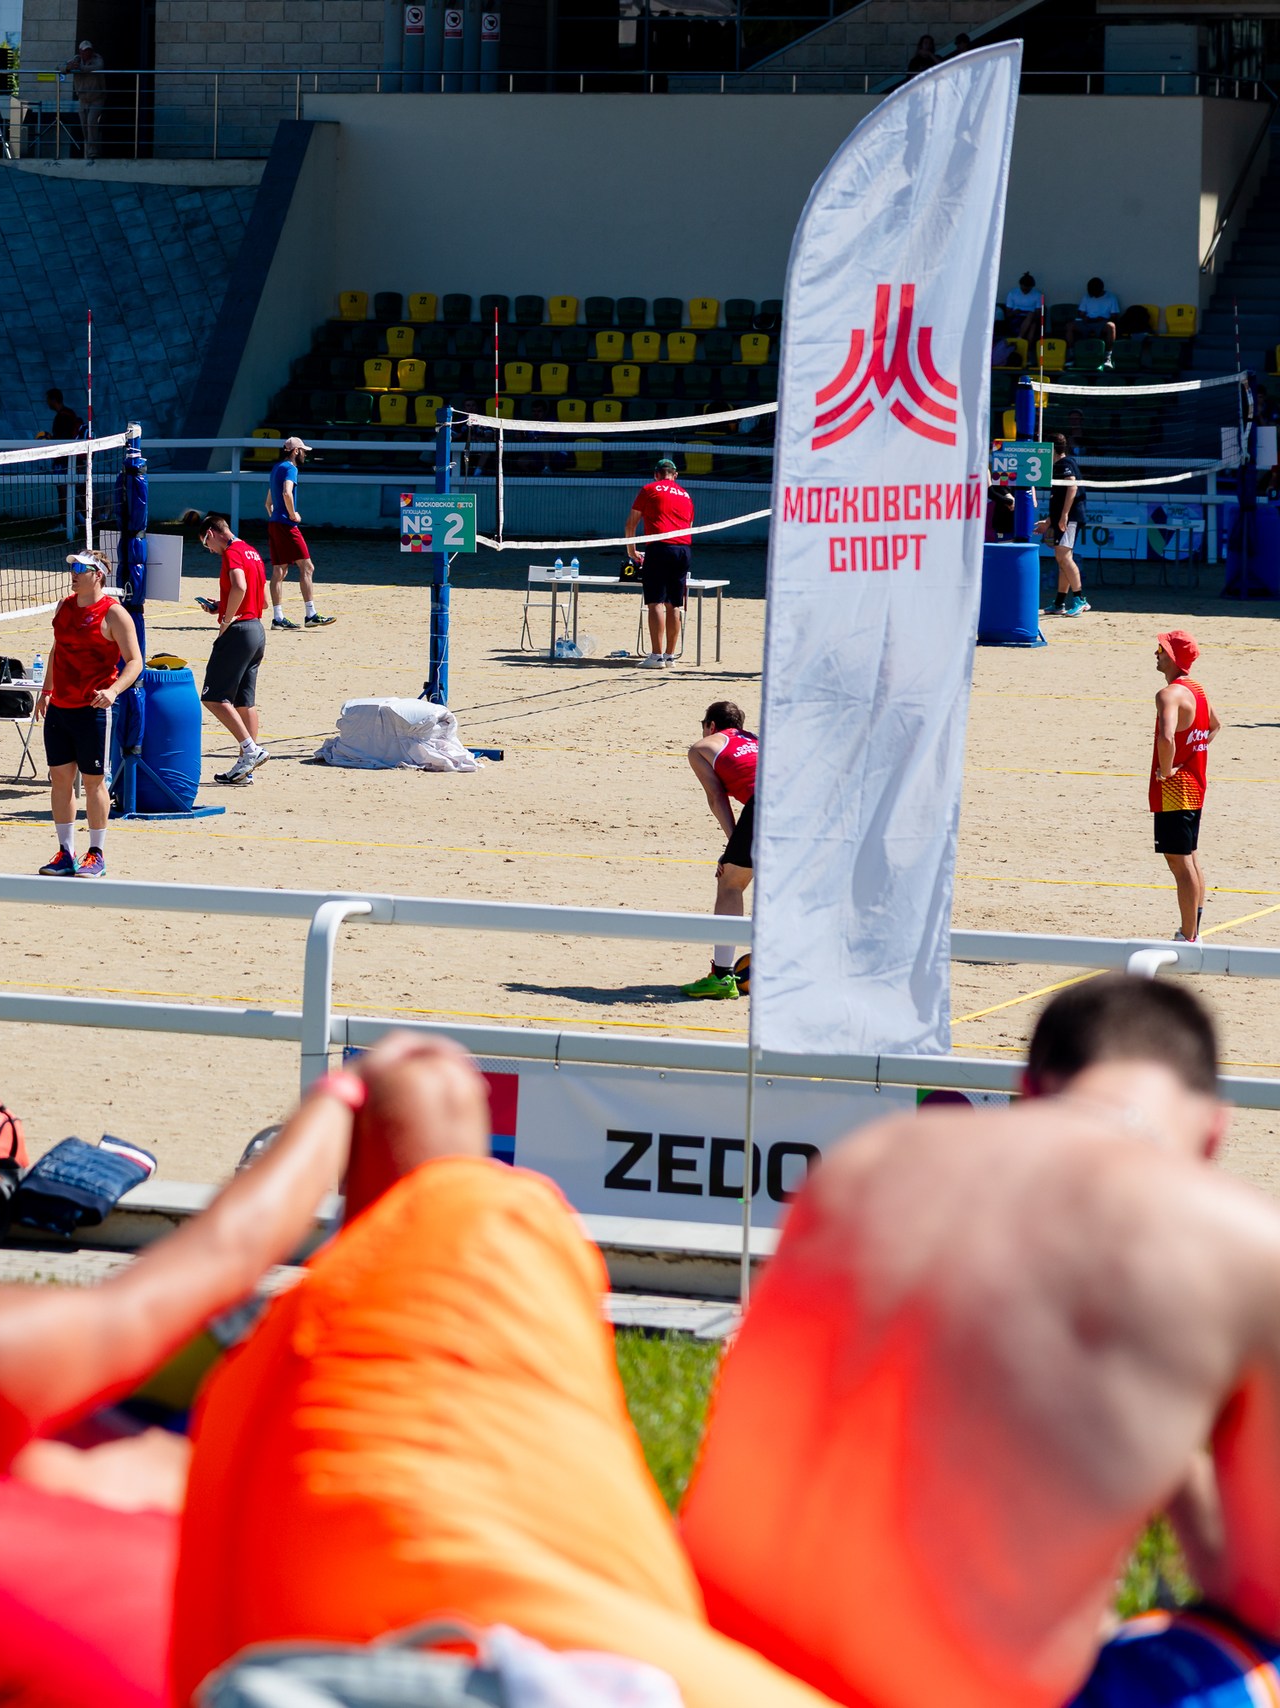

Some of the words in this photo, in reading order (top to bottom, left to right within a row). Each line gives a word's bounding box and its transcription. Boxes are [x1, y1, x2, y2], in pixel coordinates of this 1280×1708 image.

[1025, 456, 1042, 482] 3
[655, 485, 690, 499] СУДЬЯ
[783, 474, 981, 524] МОСКОВСКИЙ
[443, 513, 464, 545] 2
[829, 534, 927, 573] СПОРТ
